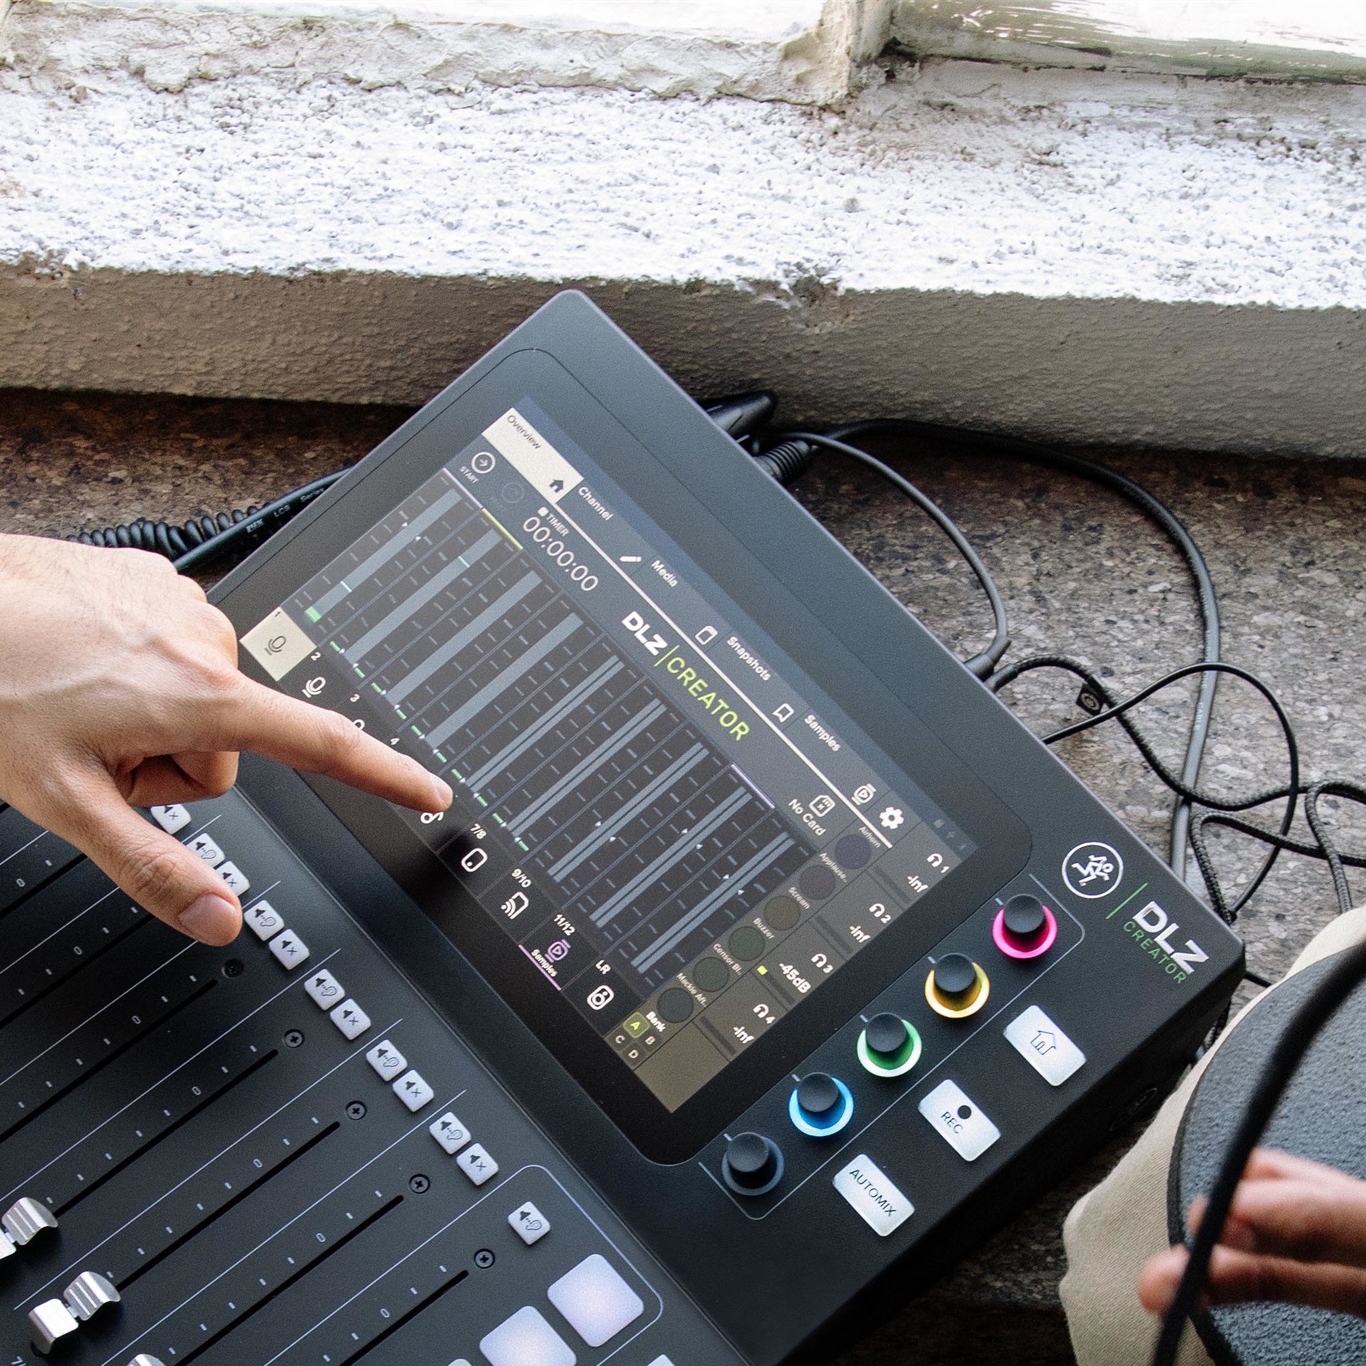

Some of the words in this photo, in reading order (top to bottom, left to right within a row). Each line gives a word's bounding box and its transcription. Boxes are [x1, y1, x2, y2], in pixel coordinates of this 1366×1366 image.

[507, 414, 541, 449] Overview
[460, 466, 479, 484] START
[578, 487, 614, 521] Channel
[546, 513, 569, 536] TIMER
[523, 517, 598, 591] 00:00:00
[651, 560, 678, 587] Media
[310, 652, 321, 661] 2
[727, 636, 772, 681] Snapshots
[622, 611, 668, 656] DLZ
[667, 657, 750, 741] CREATOR
[350, 694, 360, 702] 3
[390, 737, 400, 746] 4
[804, 715, 841, 751] Samples
[789, 799, 803, 815] No
[802, 812, 826, 836] Card
[470, 823, 487, 839] 7/8
[859, 826, 881, 848] Airhorn
[16, 878, 25, 887] 0
[511, 868, 532, 888] 9/10
[789, 887, 810, 909] Scream
[553, 913, 576, 936] 11/12
[753, 917, 775, 940] Buzzer
[880, 914, 891, 924] 2
[1132, 901, 1210, 975] DLZ
[73, 946, 83, 955] 0
[713, 943, 734, 965] Censor
[1123, 921, 1186, 984] CREATOR
[531, 949, 558, 977] Samples
[596, 960, 611, 975] LR
[823, 964, 833, 974] 3
[779, 963, 811, 993] -45dB
[132, 1015, 141, 1025] 0
[630, 1021, 641, 1031] A
[646, 1011, 666, 1032] Bank
[765, 1016, 775, 1024] 4
[615, 1035, 625, 1044] C
[645, 1036, 655, 1046] B
[628, 1050, 639, 1059] D
[192, 1086, 201, 1095] 0
[941, 1111, 963, 1134] REC
[253, 1158, 263, 1168] 0
[849, 1169, 897, 1217] AUTOMIX
[316, 1232, 326, 1242] 0
[380, 1308, 390, 1318] 0
